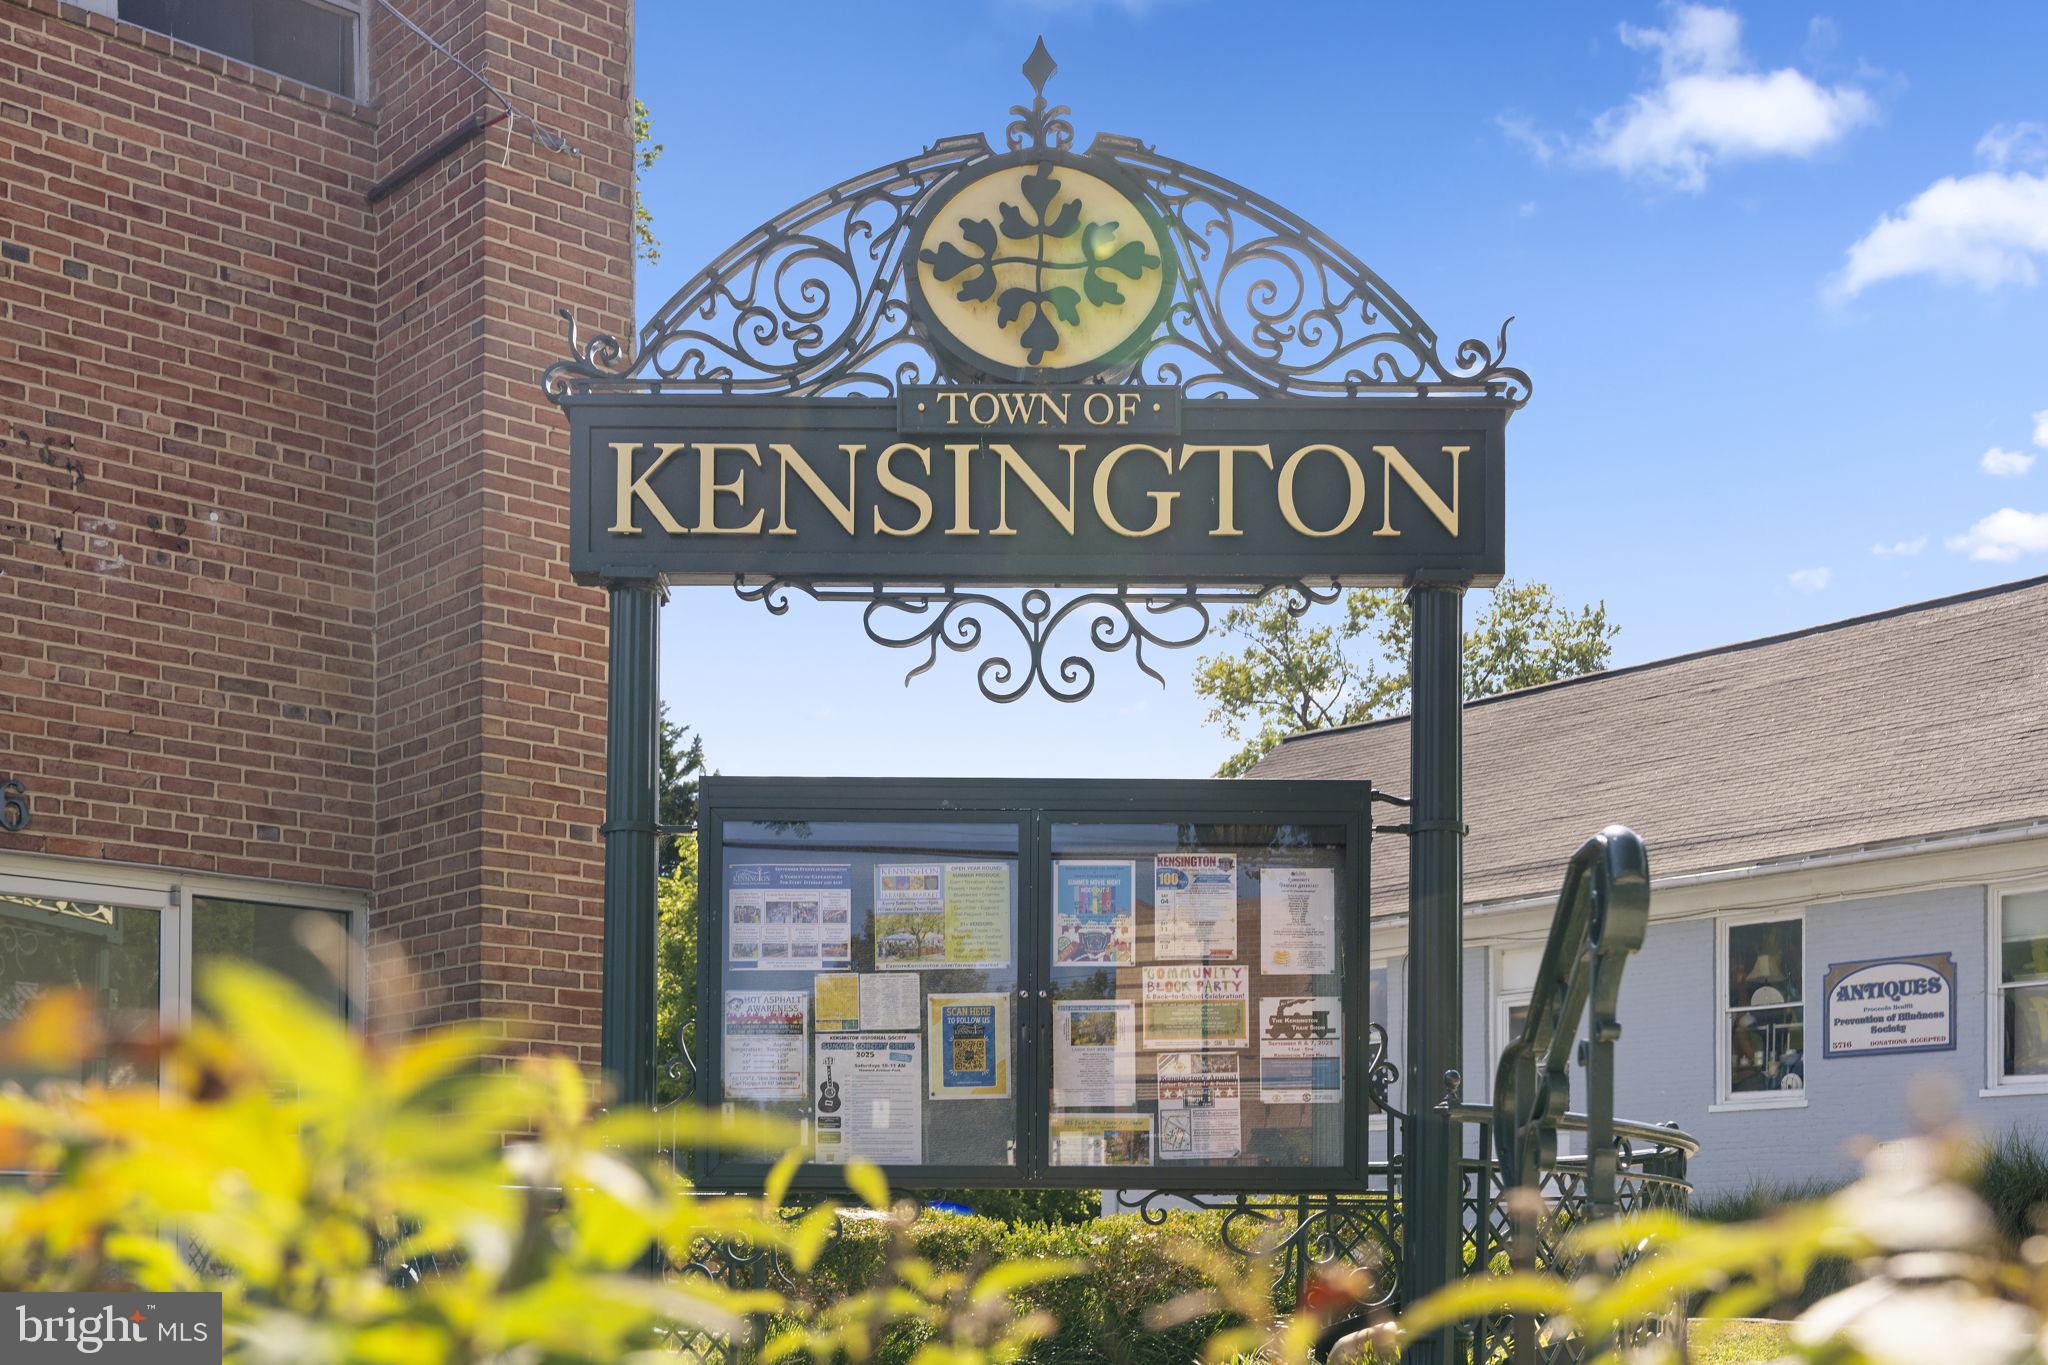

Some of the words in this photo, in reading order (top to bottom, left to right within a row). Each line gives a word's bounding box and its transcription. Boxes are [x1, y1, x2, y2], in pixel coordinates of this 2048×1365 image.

[936, 392, 1071, 425] TOWN
[1083, 391, 1141, 425] OF
[606, 441, 1471, 538] KENSINGTON
[1157, 856, 1216, 867] KENSINGTON
[881, 866, 939, 875] KENSINGTON
[1158, 872, 1179, 886] 100
[1147, 967, 1242, 979] COMMUNITY
[1147, 980, 1192, 992] BLOCK
[1196, 980, 1242, 993] PARTY
[1836, 976, 1942, 1001] ANTIQUES
[744, 996, 760, 1004] HOT
[763, 995, 801, 1004] ASPHALT
[746, 1004, 799, 1012] AWARENESS
[946, 1007, 968, 1016] SCAN
[970, 1007, 991, 1016] HERE
[947, 1016, 956, 1024] TO
[956, 1016, 981, 1024] FOLLOW
[982, 1016, 991, 1024] US
[1834, 1015, 1885, 1026] Prevention
[1886, 1013, 1897, 1022] of
[1898, 1010, 1945, 1022] Blindness
[1870, 1023, 1906, 1034] Society
[821, 1042, 855, 1050] SUMMER
[855, 1042, 888, 1050] CONCERT
[1832, 1041, 1852, 1049] 5716
[1870, 1038, 1908, 1047] DONATIONS
[1910, 1035, 1947, 1044] ACCEPTED
[1160, 1074, 1208, 1082] Kensington's
[1209, 1073, 1237, 1082] Annual
